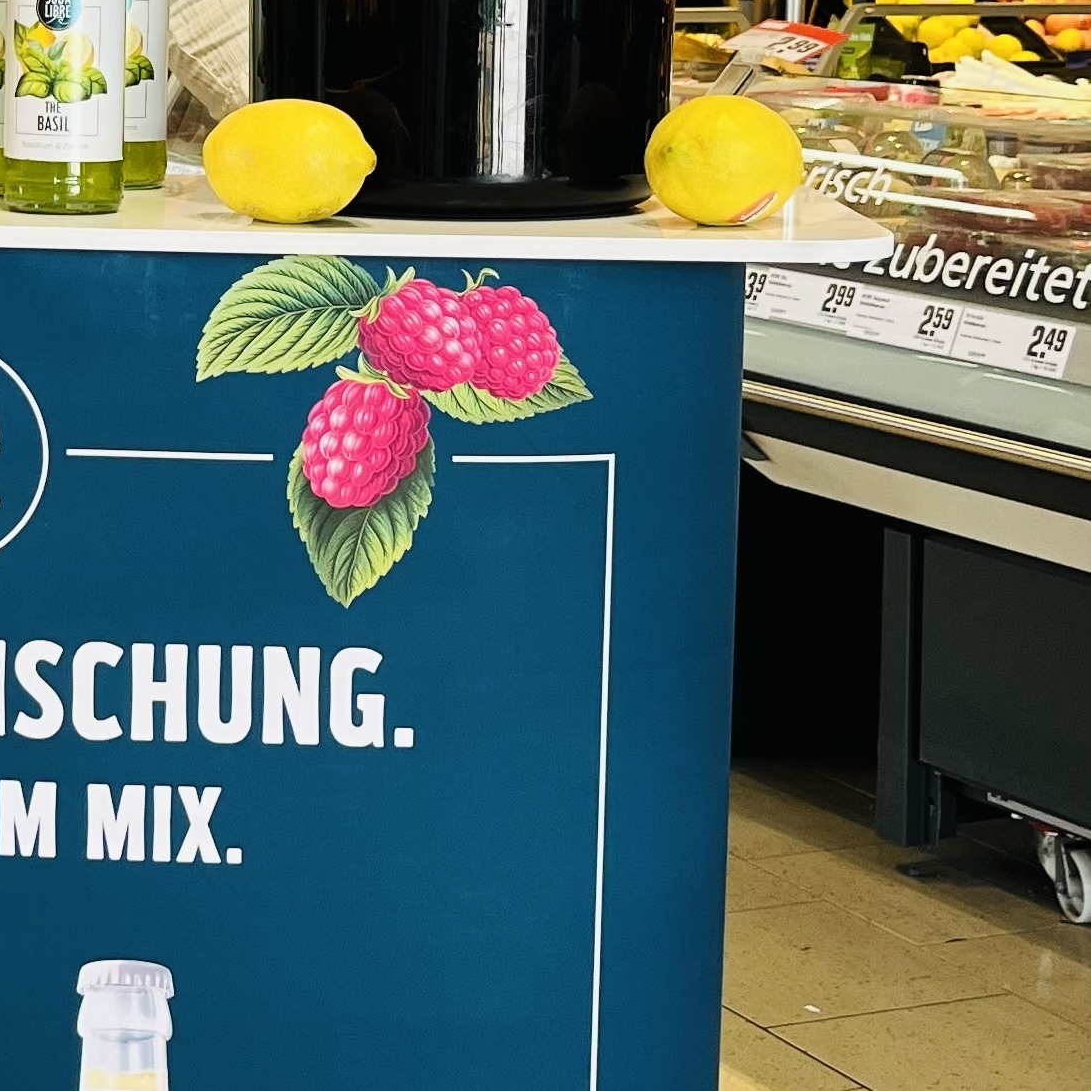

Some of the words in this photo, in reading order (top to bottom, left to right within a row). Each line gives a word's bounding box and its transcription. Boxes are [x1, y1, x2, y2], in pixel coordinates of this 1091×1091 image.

[44, 4, 72, 18] LIBRE
[45, 101, 61, 114] THE
[37, 115, 70, 132] BASIL
[821, 283, 856, 314] 2.99
[917, 305, 955, 336] 2.59
[1026, 325, 1068, 359] 2.49
[86, 782, 243, 865] MIX.
